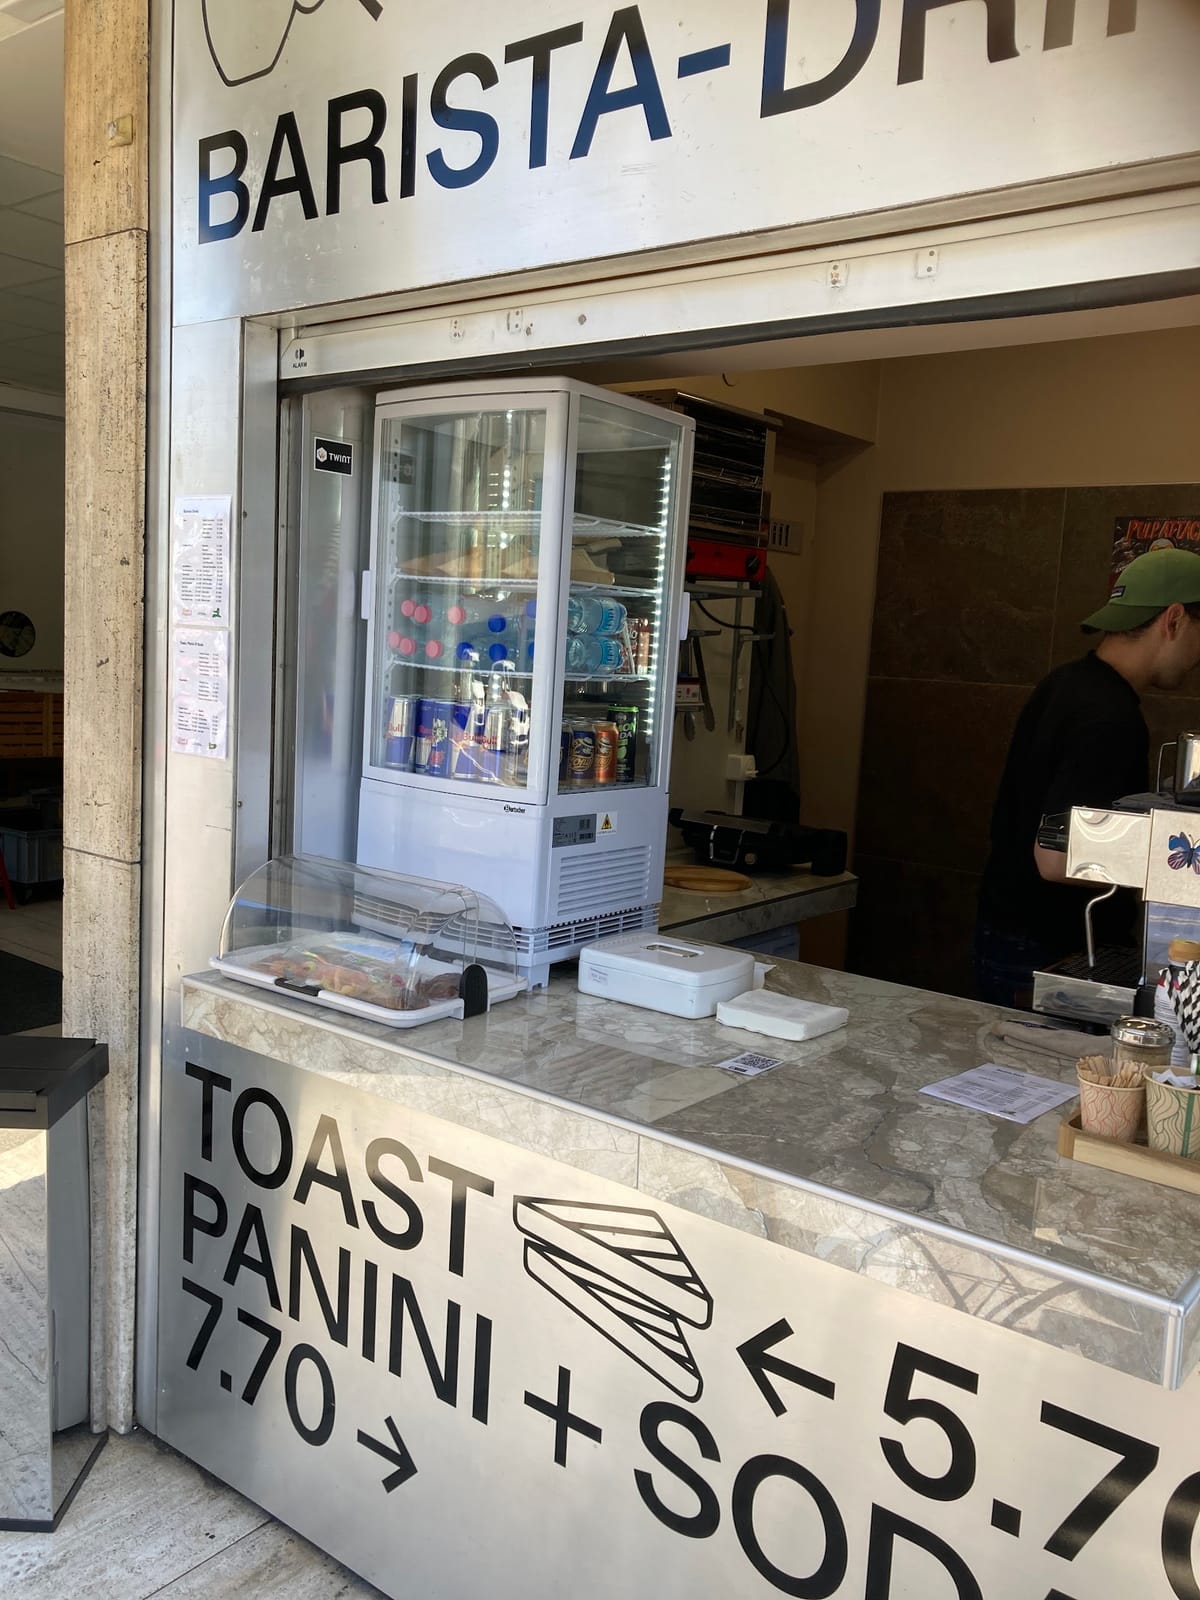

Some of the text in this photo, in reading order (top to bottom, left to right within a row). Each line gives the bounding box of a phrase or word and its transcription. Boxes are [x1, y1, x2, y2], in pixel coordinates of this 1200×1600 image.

[292, 361, 308, 369] ALARM
[185, 1061, 495, 1278] TOAST
[181, 1276, 337, 1447] 7.70
[182, 1171, 493, 1426] PANINI
[633, 1400, 1086, 1600] SOD
